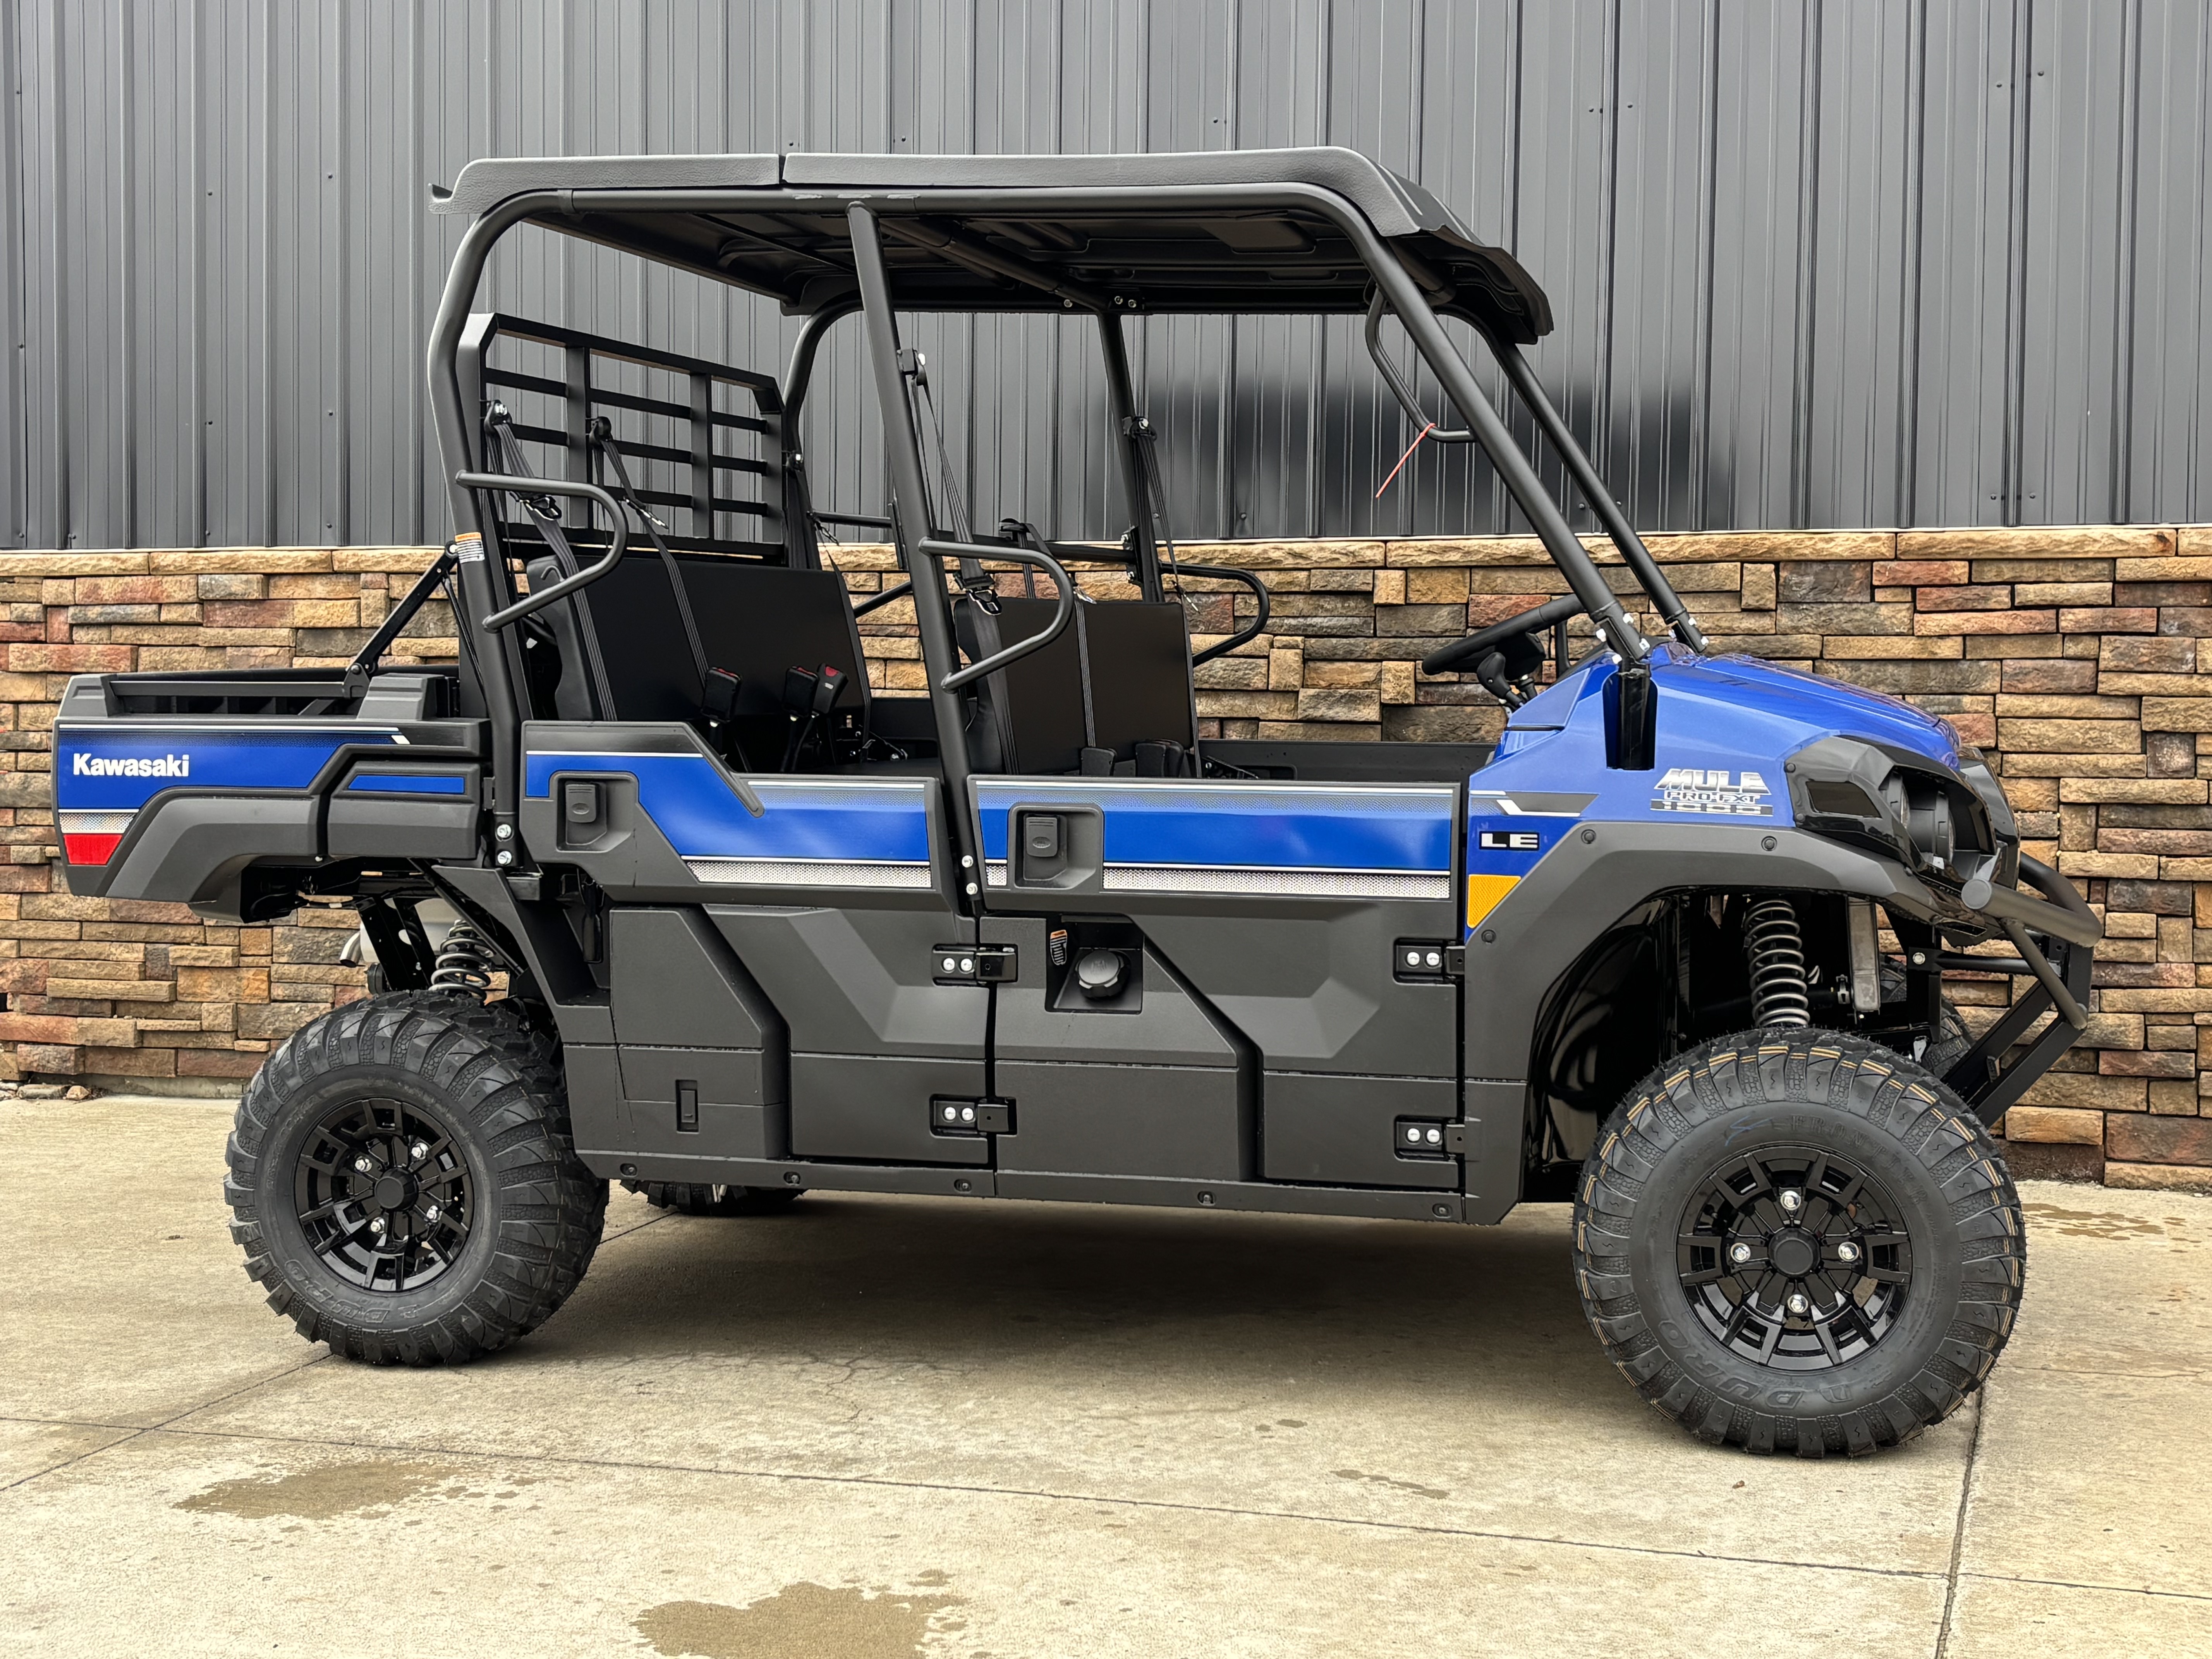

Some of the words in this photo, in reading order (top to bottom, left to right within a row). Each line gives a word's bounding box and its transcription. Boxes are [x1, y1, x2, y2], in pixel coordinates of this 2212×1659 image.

[73, 753, 189, 777] Kawasaki
[1654, 768, 1772, 795] MULE
[1662, 801, 1761, 814] 1000
[1481, 833, 1538, 848] LE
[1790, 1115, 1929, 1205] FRONTIER
[1658, 1319, 1804, 1409] DURO
